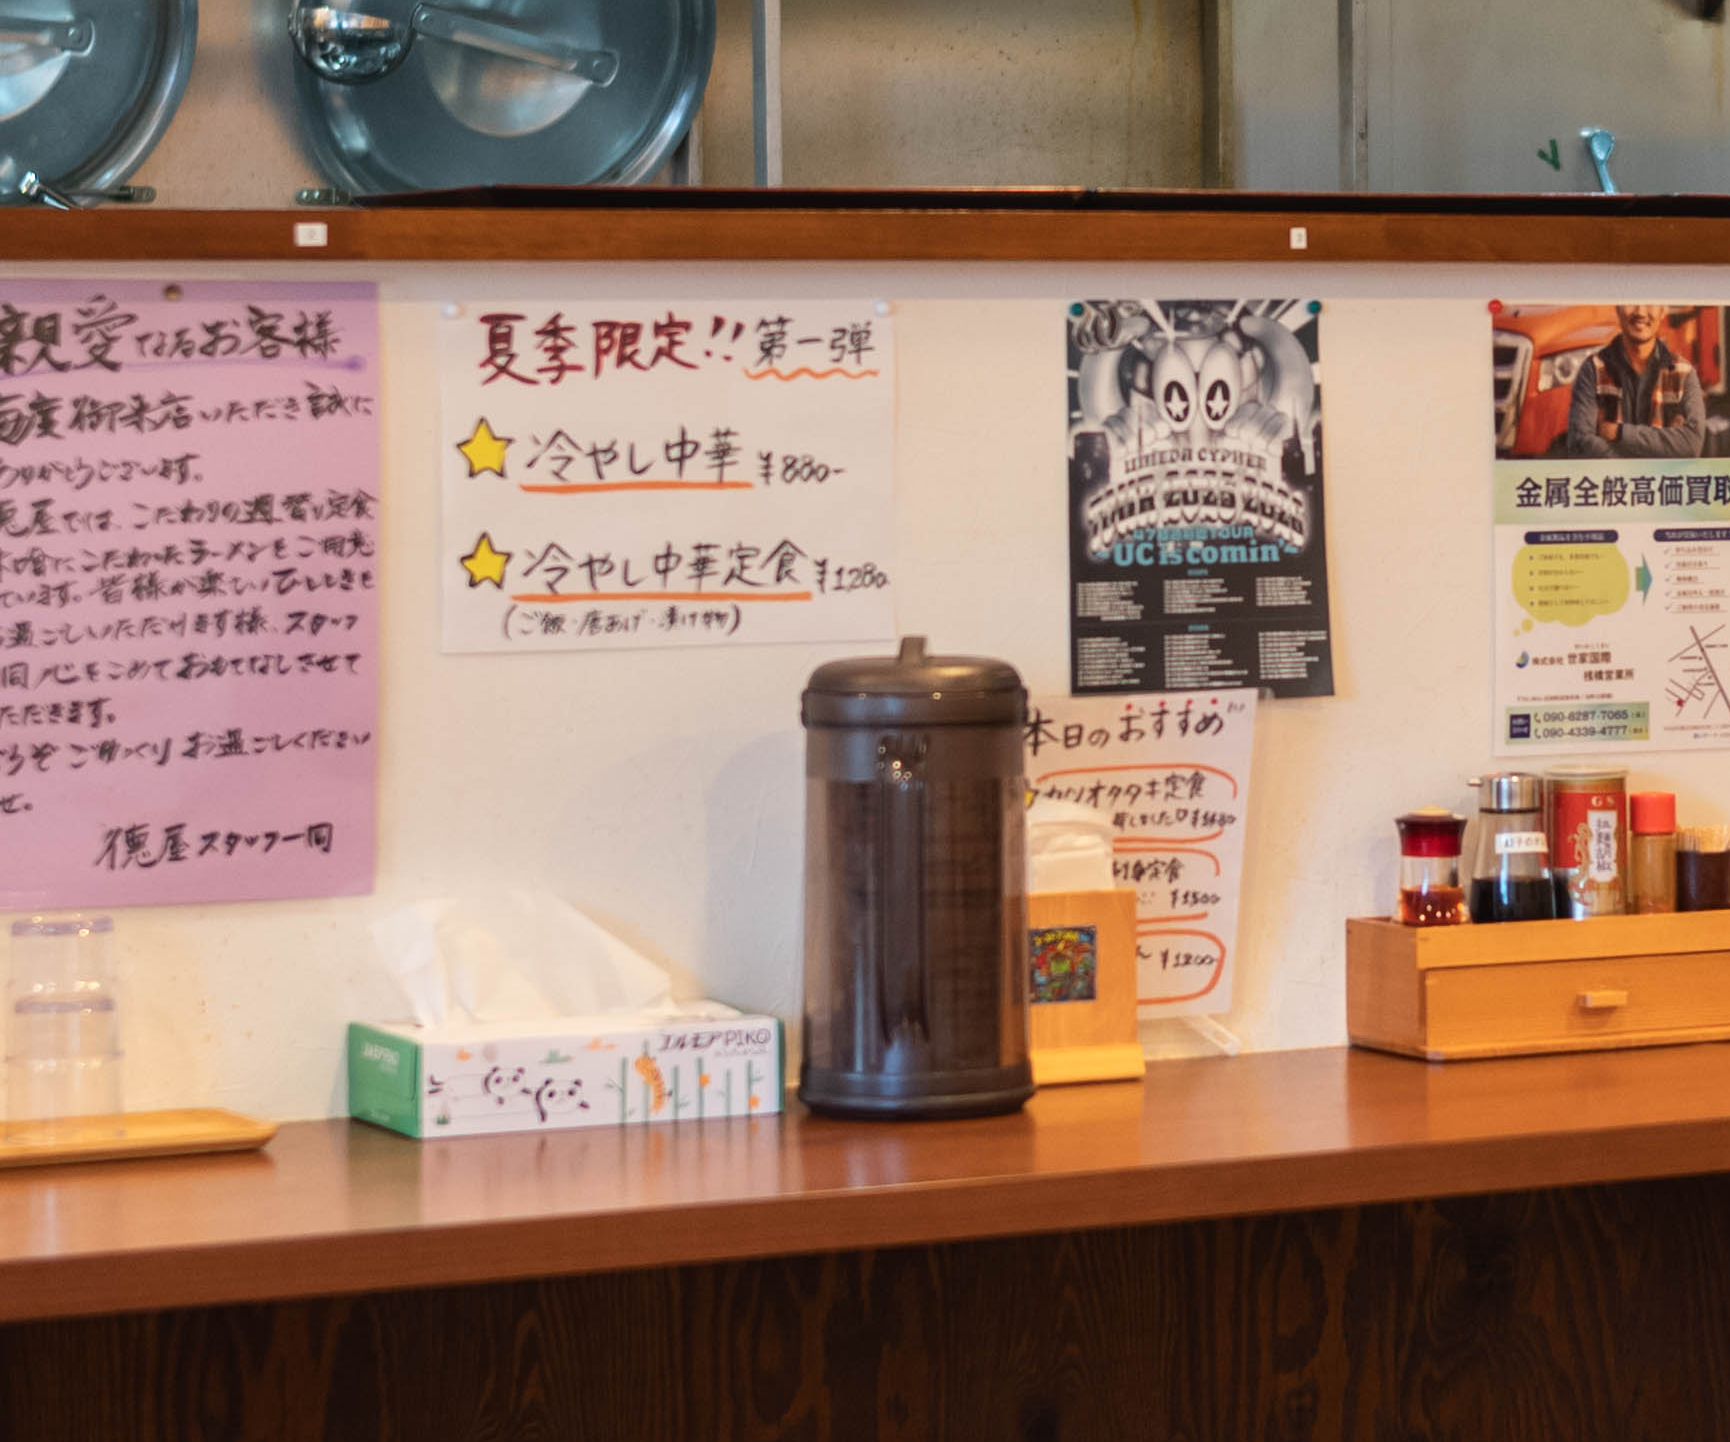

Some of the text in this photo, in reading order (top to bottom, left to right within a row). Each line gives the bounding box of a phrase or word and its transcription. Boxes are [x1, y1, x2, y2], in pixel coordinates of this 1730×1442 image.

[0, 295, 343, 375] 親愛なるお客様
[755, 315, 875, 366] 第一弾
[525, 424, 743, 484] 冷やし中華
[0, 529, 376, 574] 噌にこだわったラーメンをご用意
[522, 538, 807, 595] 冷やし中華定食
[1113, 543, 1154, 566] UC
[0, 728, 371, 775] うぞごゆっくりお過ごしください
[1024, 707, 1224, 756] 本日のおすすめ
[725, 1028, 771, 1046] PIKO
